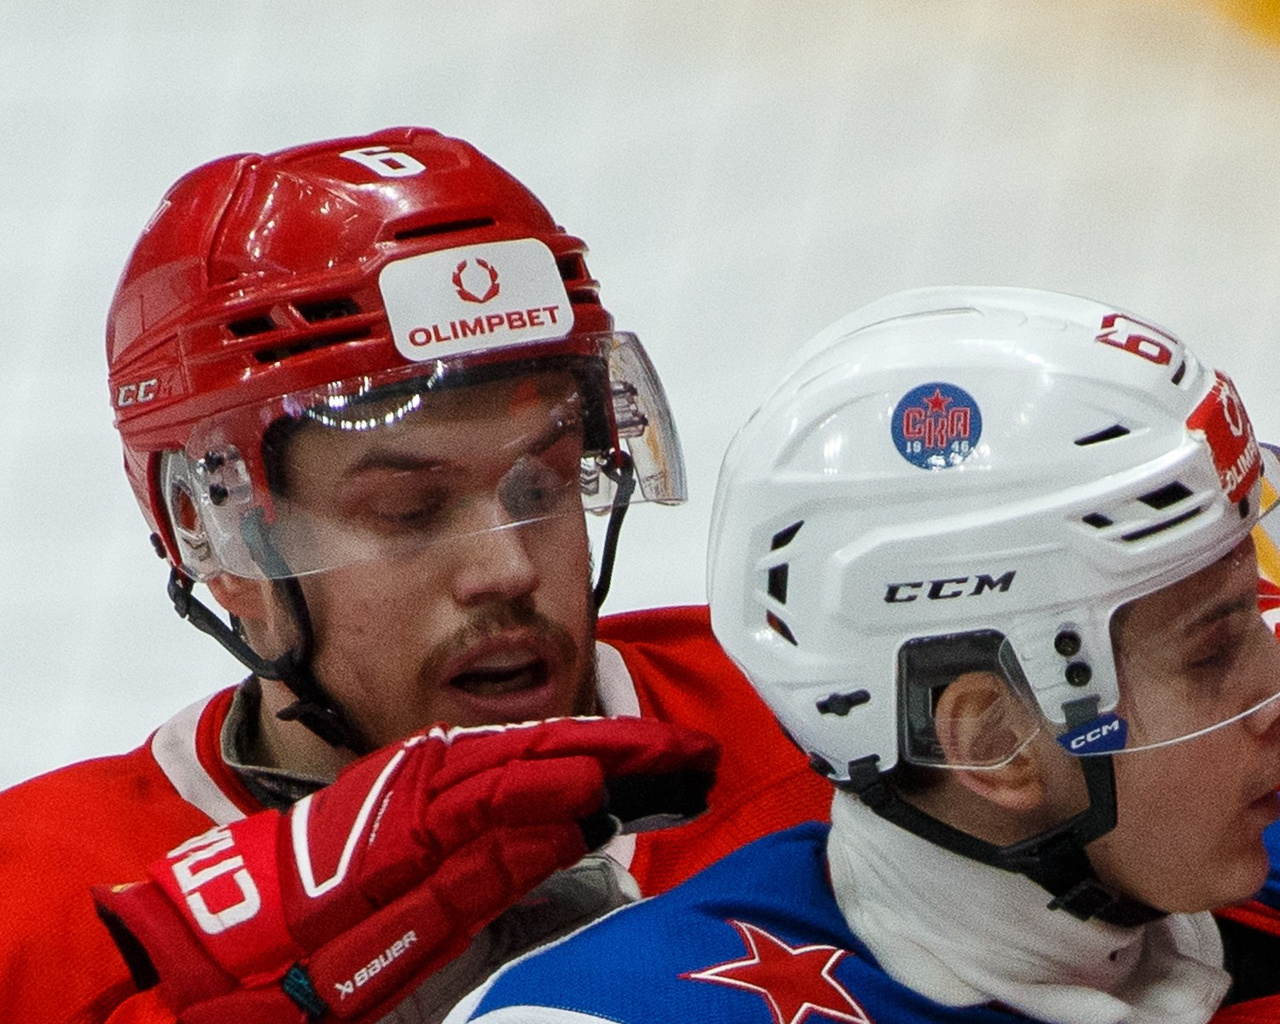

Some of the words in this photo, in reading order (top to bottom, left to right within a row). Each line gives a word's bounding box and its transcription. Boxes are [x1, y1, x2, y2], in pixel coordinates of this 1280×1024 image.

[340, 146, 427, 178] 6
[408, 305, 559, 347] OLIMPBET
[884, 570, 1017, 604] CCM
[1070, 719, 1120, 750] CCM
